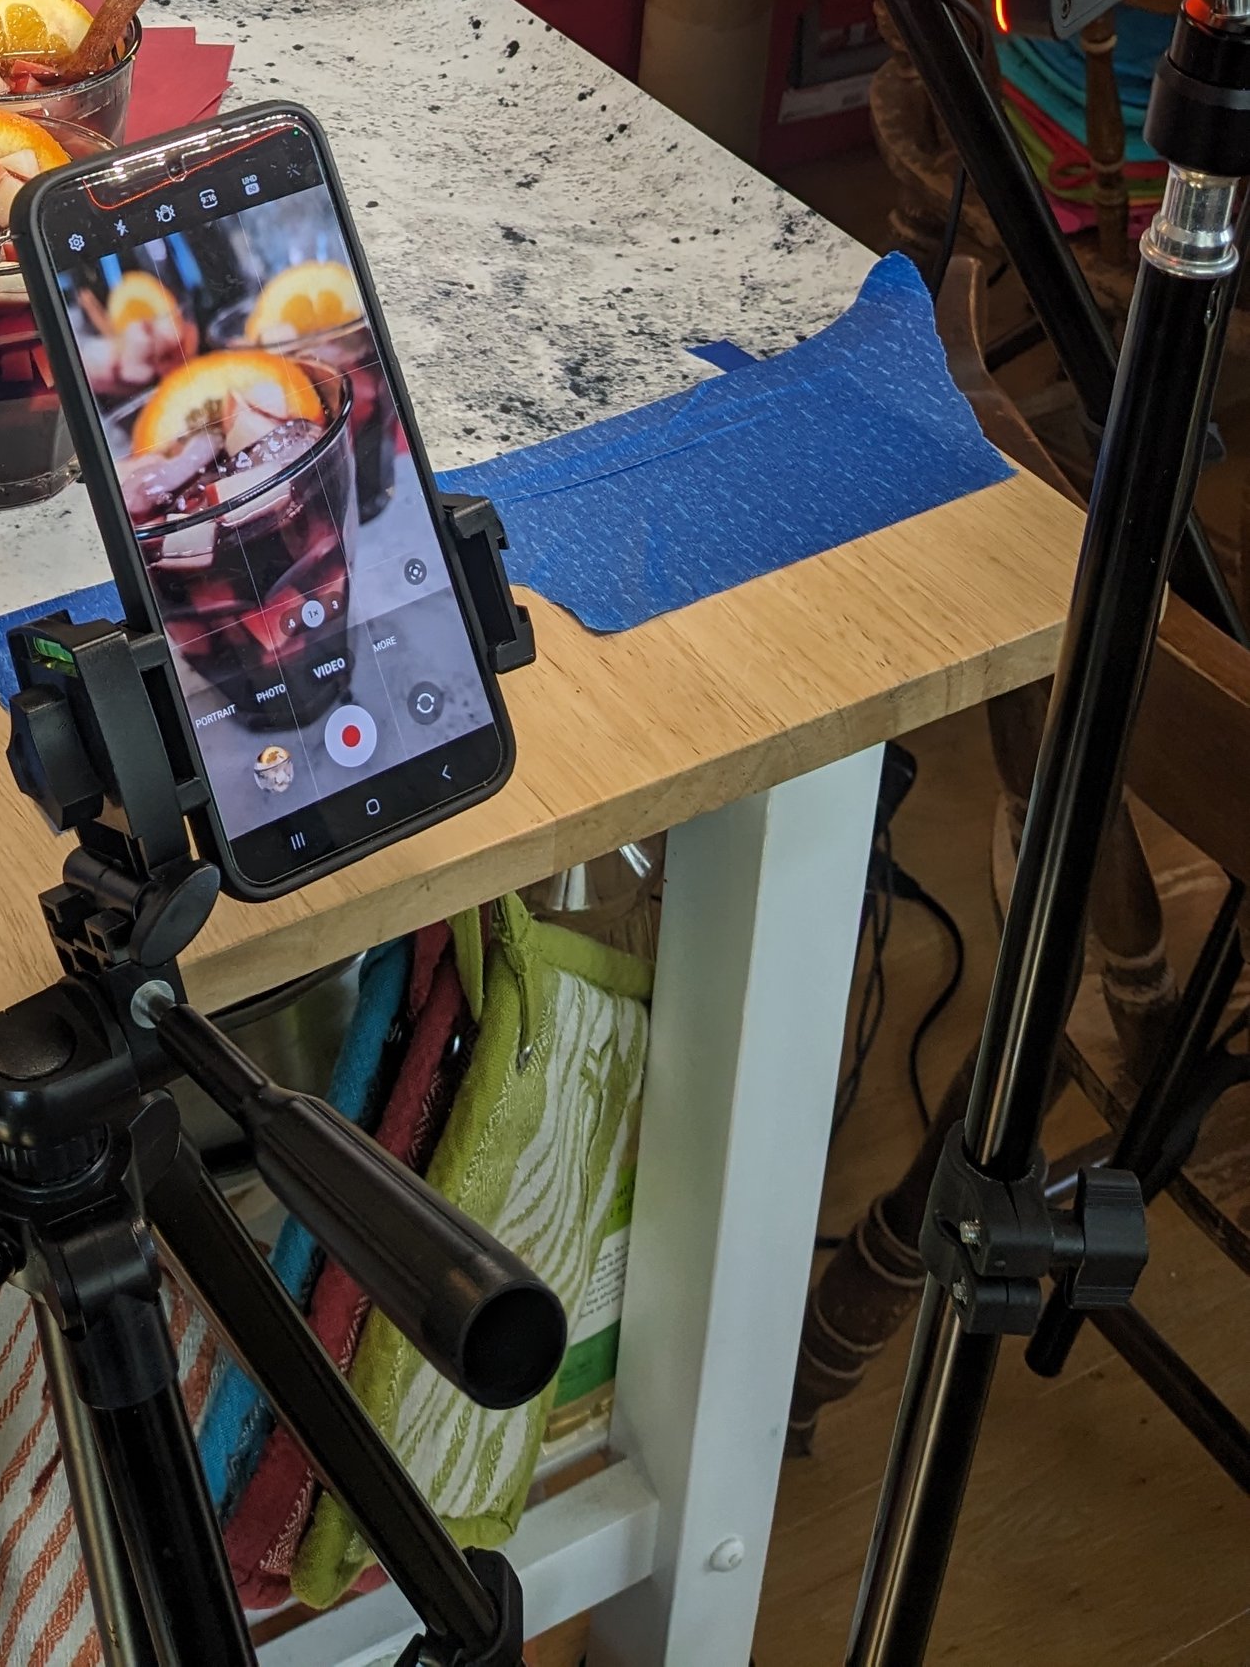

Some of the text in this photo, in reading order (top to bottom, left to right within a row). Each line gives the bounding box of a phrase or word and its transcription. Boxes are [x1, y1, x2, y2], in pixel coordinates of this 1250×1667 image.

[241, 174, 257, 185] UHD
[200, 194, 217, 204] 9:16
[195, 635, 398, 728] PORTRAIT PHOTO VIDEO MORE
